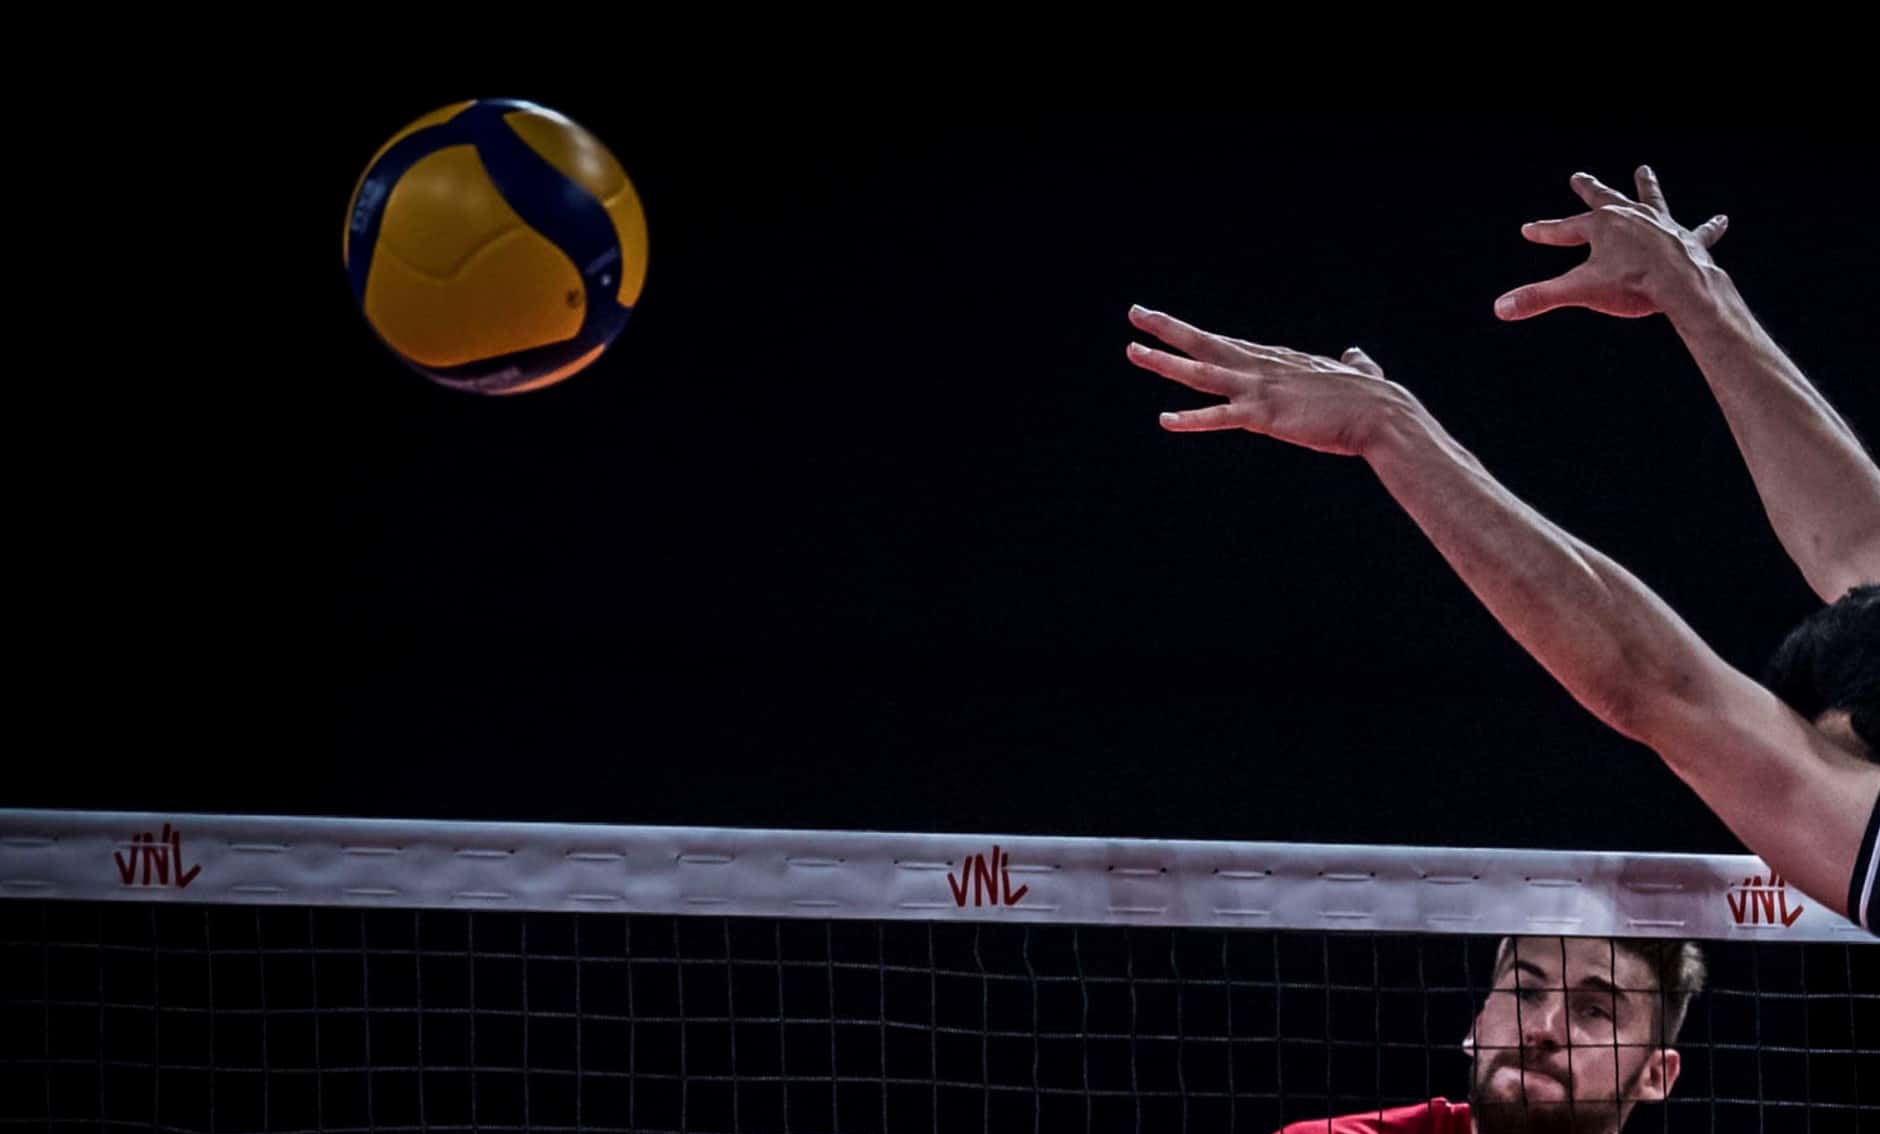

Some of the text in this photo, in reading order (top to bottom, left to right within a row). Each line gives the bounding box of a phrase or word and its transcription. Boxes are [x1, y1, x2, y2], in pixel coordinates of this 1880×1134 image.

[114, 823, 201, 888] VNL
[947, 845, 1028, 907] VNL
[1727, 873, 1804, 927] VNL
